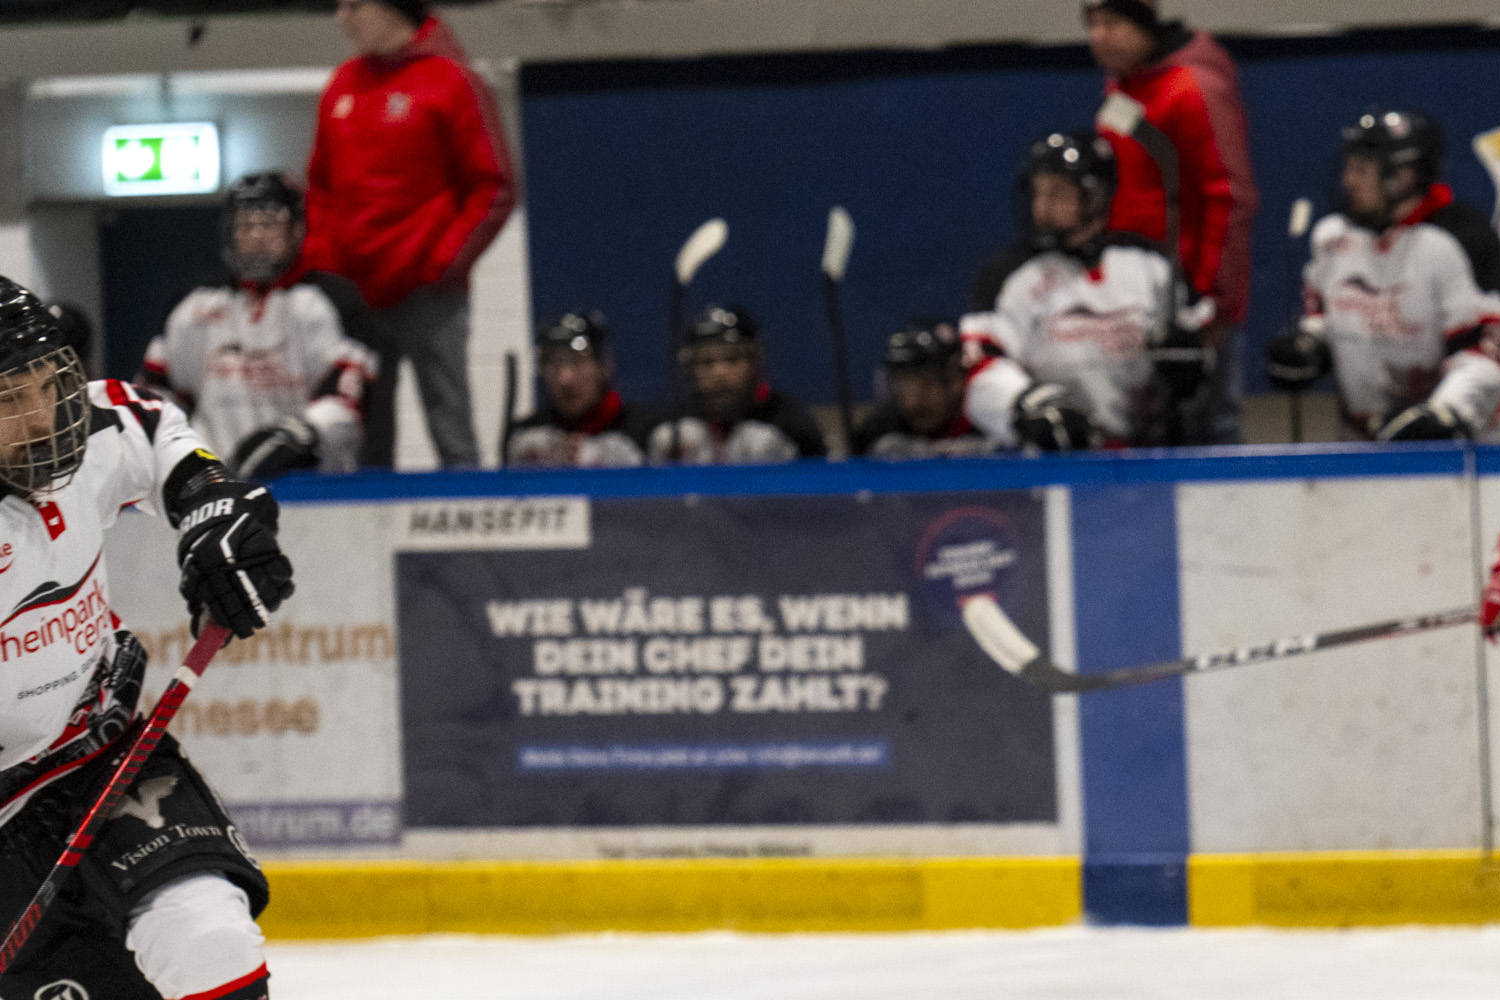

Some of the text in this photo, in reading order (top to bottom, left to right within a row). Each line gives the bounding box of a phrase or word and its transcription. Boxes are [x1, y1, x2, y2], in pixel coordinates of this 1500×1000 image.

[486, 586, 909, 637] WIE WÄRE ES, WENN
[534, 633, 864, 675] DEIN CHEF DEIN
[512, 673, 889, 715] TRAINING ZAHLT?
[111, 822, 222, 871] Vision Town
